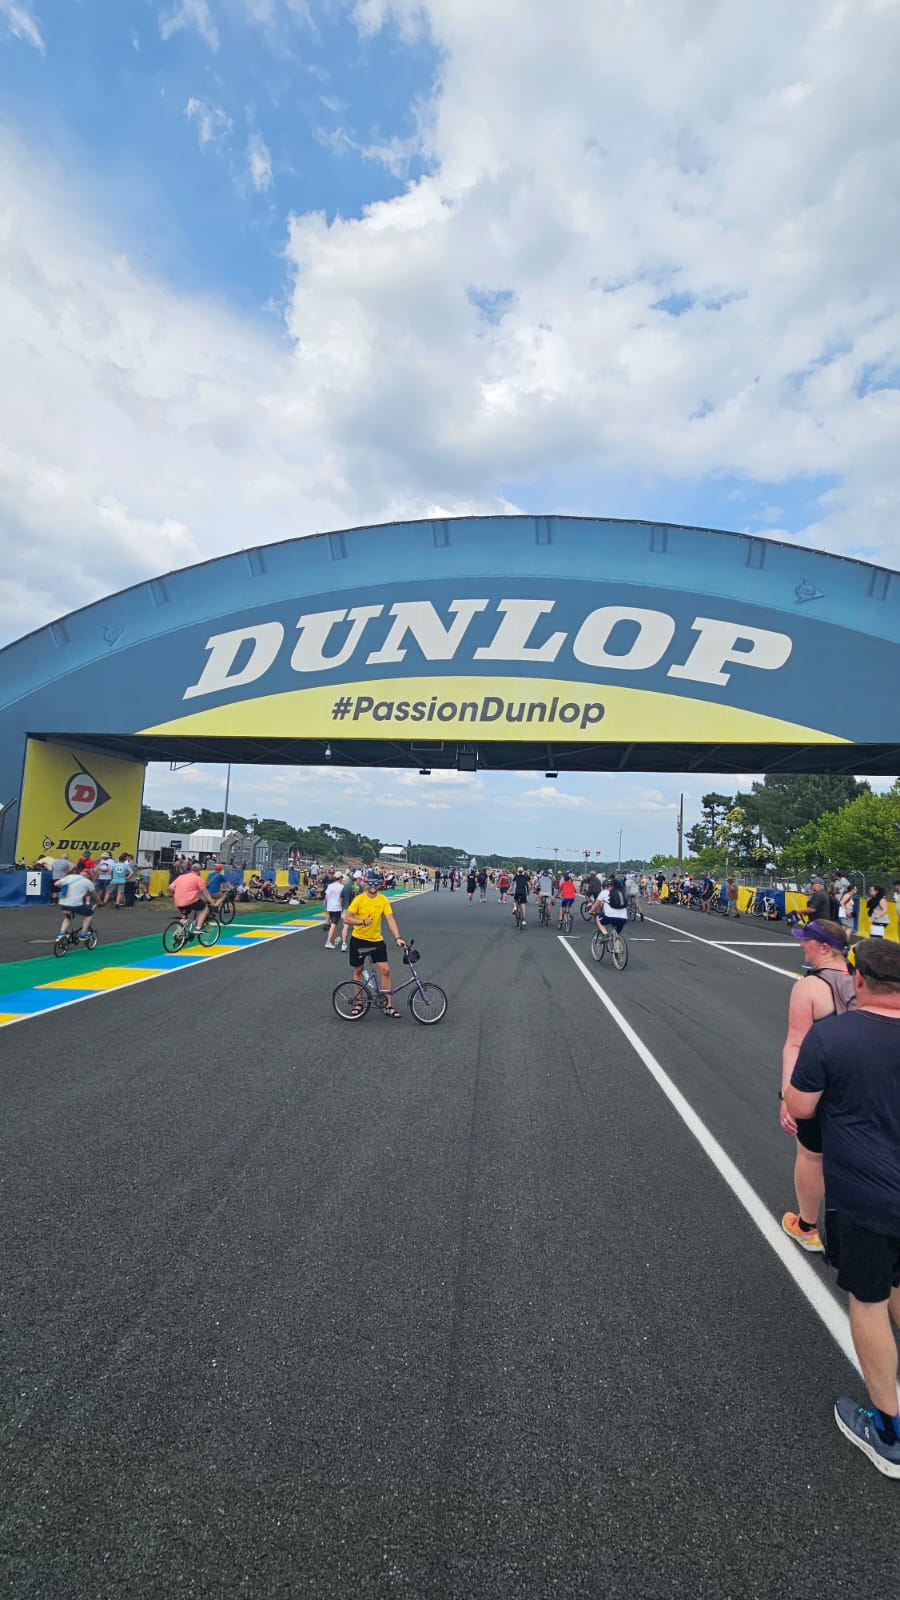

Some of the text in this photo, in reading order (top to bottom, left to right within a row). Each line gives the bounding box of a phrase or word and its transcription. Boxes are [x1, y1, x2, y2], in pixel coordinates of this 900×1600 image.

[182, 598, 793, 701] DUNLOP
[332, 696, 605, 730] #PassionDunlop
[71, 784, 96, 802] D
[56, 840, 121, 851] DUNLOP
[29, 878, 37, 887] 4
